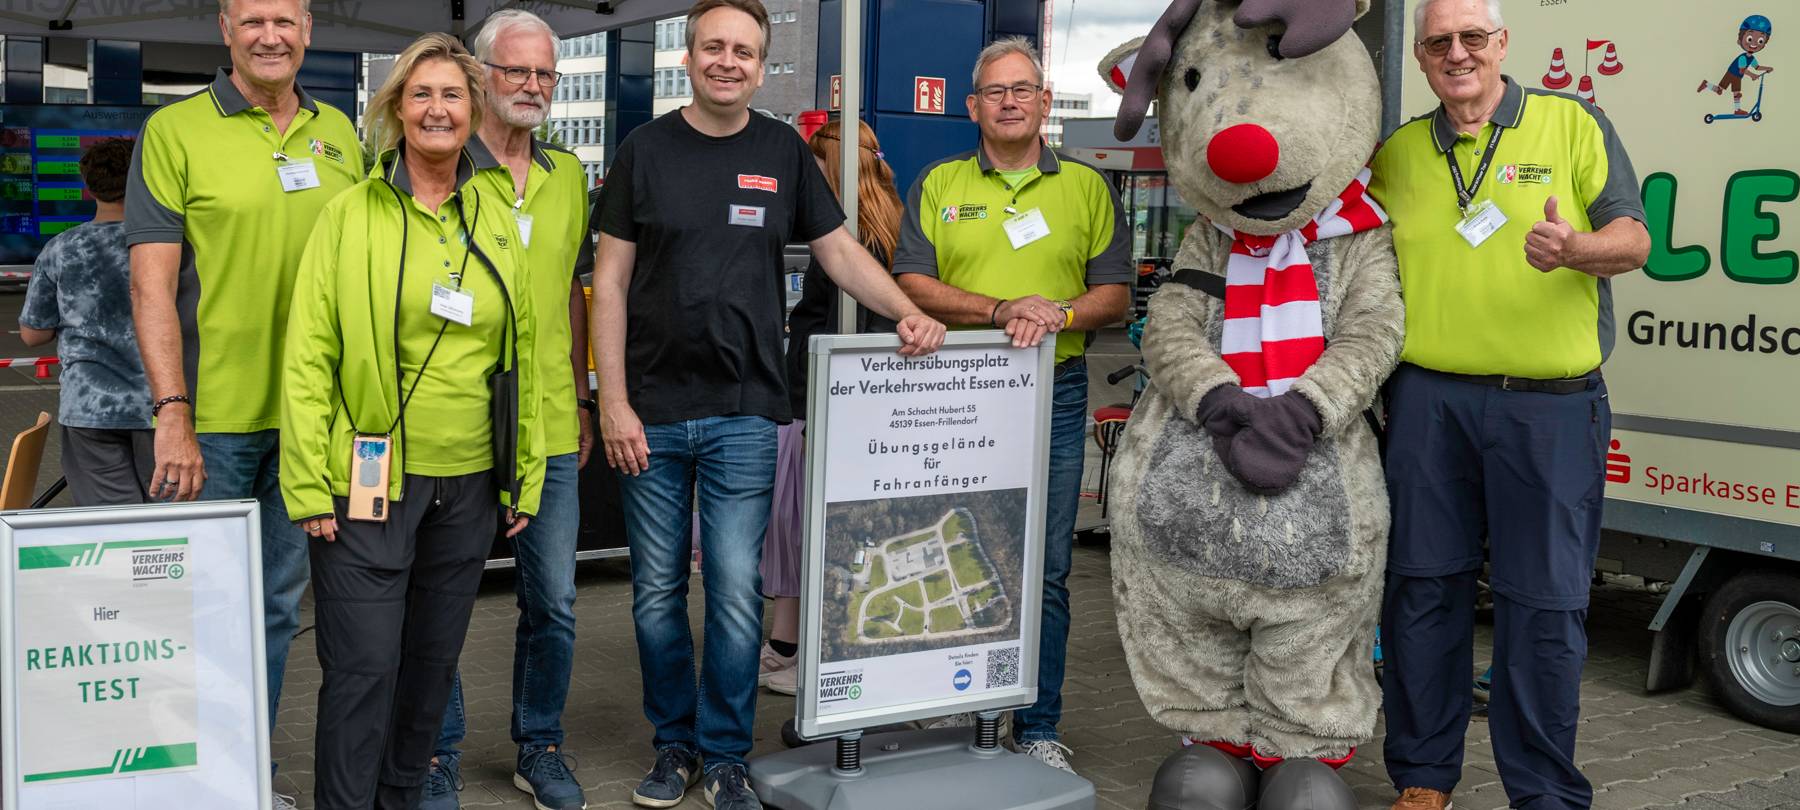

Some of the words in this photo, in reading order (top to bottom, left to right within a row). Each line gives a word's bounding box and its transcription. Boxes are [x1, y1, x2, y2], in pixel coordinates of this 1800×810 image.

[860, 353, 1009, 372] Verkehrsübungsplatz
[830, 381, 856, 395] der
[859, 376, 966, 394] Verkehrswacht
[969, 375, 1005, 390] Essen
[1008, 374, 1034, 388] e.V.
[892, 408, 906, 416] Am
[908, 406, 937, 416] Schacht
[939, 404, 965, 415] Hubert
[967, 404, 976, 413] 55
[889, 420, 912, 429] 45139
[914, 416, 978, 428] Essen-Frillendorf
[868, 435, 996, 455] Übungsgelände
[924, 457, 941, 470] für
[873, 473, 988, 492] Fahranfänger
[1645, 466, 1776, 505] Sparkasse
[132, 552, 184, 565] VERKEHRS
[132, 564, 168, 576] WACHT
[93, 606, 120, 621] Hier
[26, 638, 187, 671] REAKTIONS-
[820, 673, 863, 688] VERKEHRS
[78, 677, 140, 703] TEST
[820, 685, 850, 699] WACHT
